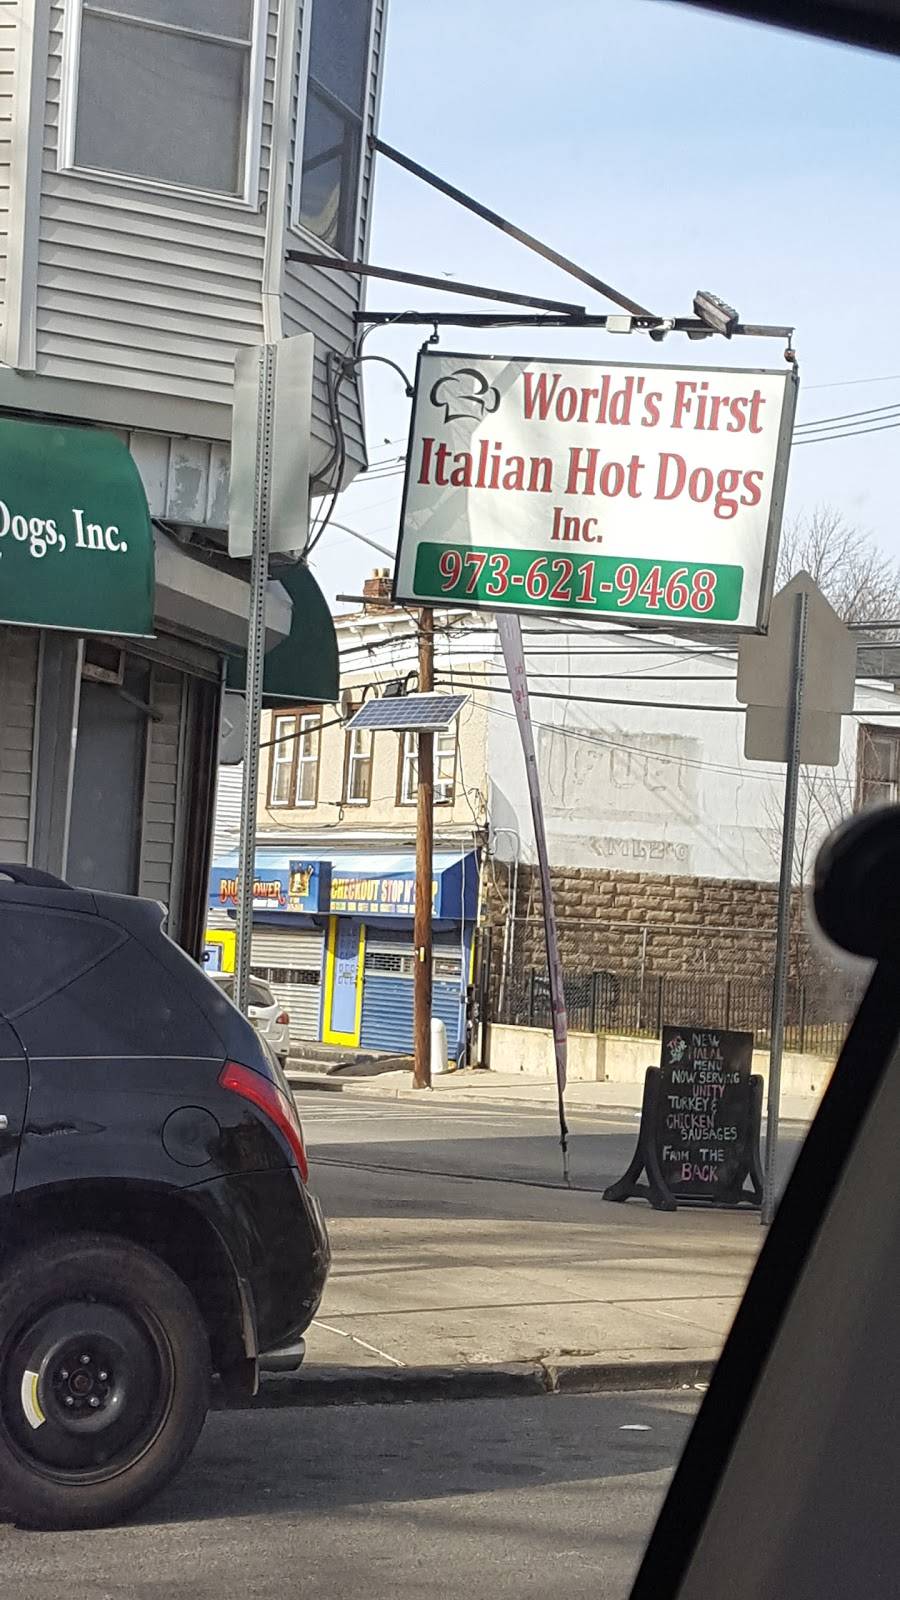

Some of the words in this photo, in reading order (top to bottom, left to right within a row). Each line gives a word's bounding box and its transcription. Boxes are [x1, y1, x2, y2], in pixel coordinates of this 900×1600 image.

[522, 371, 663, 427] World's
[670, 380, 767, 434] First
[416, 437, 554, 493] Italian
[563, 447, 646, 499] Hot
[654, 452, 765, 520] Dogs
[72, 508, 128, 552] Inc.
[550, 506, 603, 543] Inc.
[438, 550, 718, 612] 973-621-9468
[252, 878, 285, 905] OWER
[331, 878, 381, 901] CHECKOUT
[381, 880, 404, 902] STOP
[692, 1033, 720, 1047] NEW
[693, 1060, 723, 1071] MENU
[671, 1070, 698, 1084] NOW
[692, 1084, 725, 1099] UNITY
[667, 1095, 709, 1112] TURKEY
[666, 1113, 715, 1129] CHICKEN
[680, 1127, 738, 1141] SAUSAGES
[699, 1148, 725, 1162] THE
[681, 1162, 719, 1182] BACK
